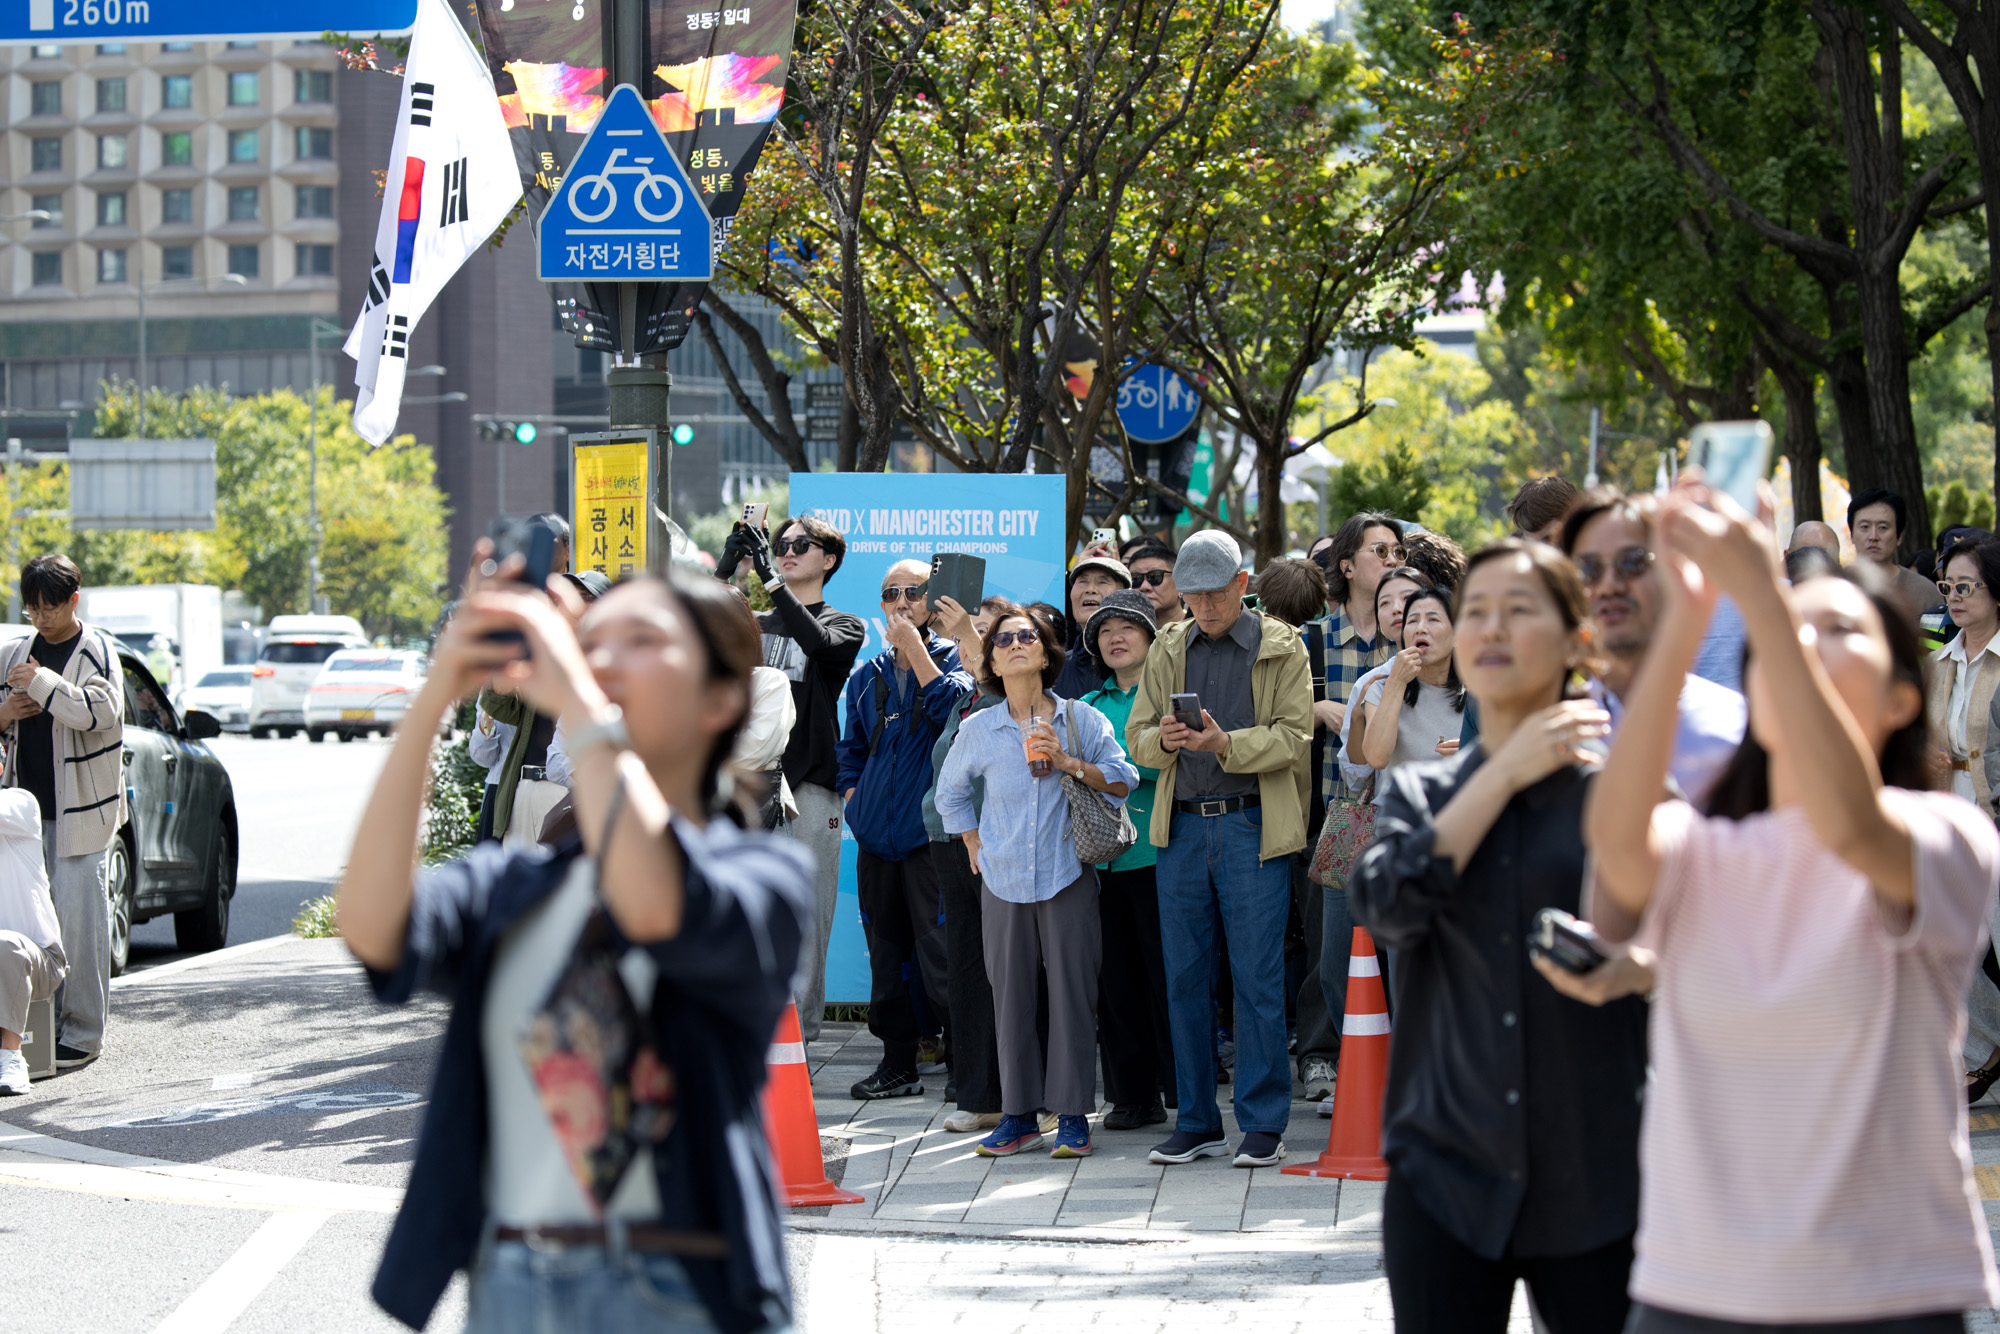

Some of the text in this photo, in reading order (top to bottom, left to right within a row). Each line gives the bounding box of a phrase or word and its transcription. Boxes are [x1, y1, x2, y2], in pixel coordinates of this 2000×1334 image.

[63, 0, 149, 25] 260m
[723, 7, 750, 25] 일대
[538, 151, 560, 171] 동,
[690, 148, 728, 169] 정동,
[701, 173, 734, 193] 빛을
[565, 242, 681, 271] 자전거횡단
[853, 508, 866, 536] X
[869, 508, 994, 536] MANCHESTER
[998, 509, 1040, 537] CITY
[851, 541, 1008, 554] DRIVE OF THE CHAMPIONS
[828, 817, 839, 830] 93
